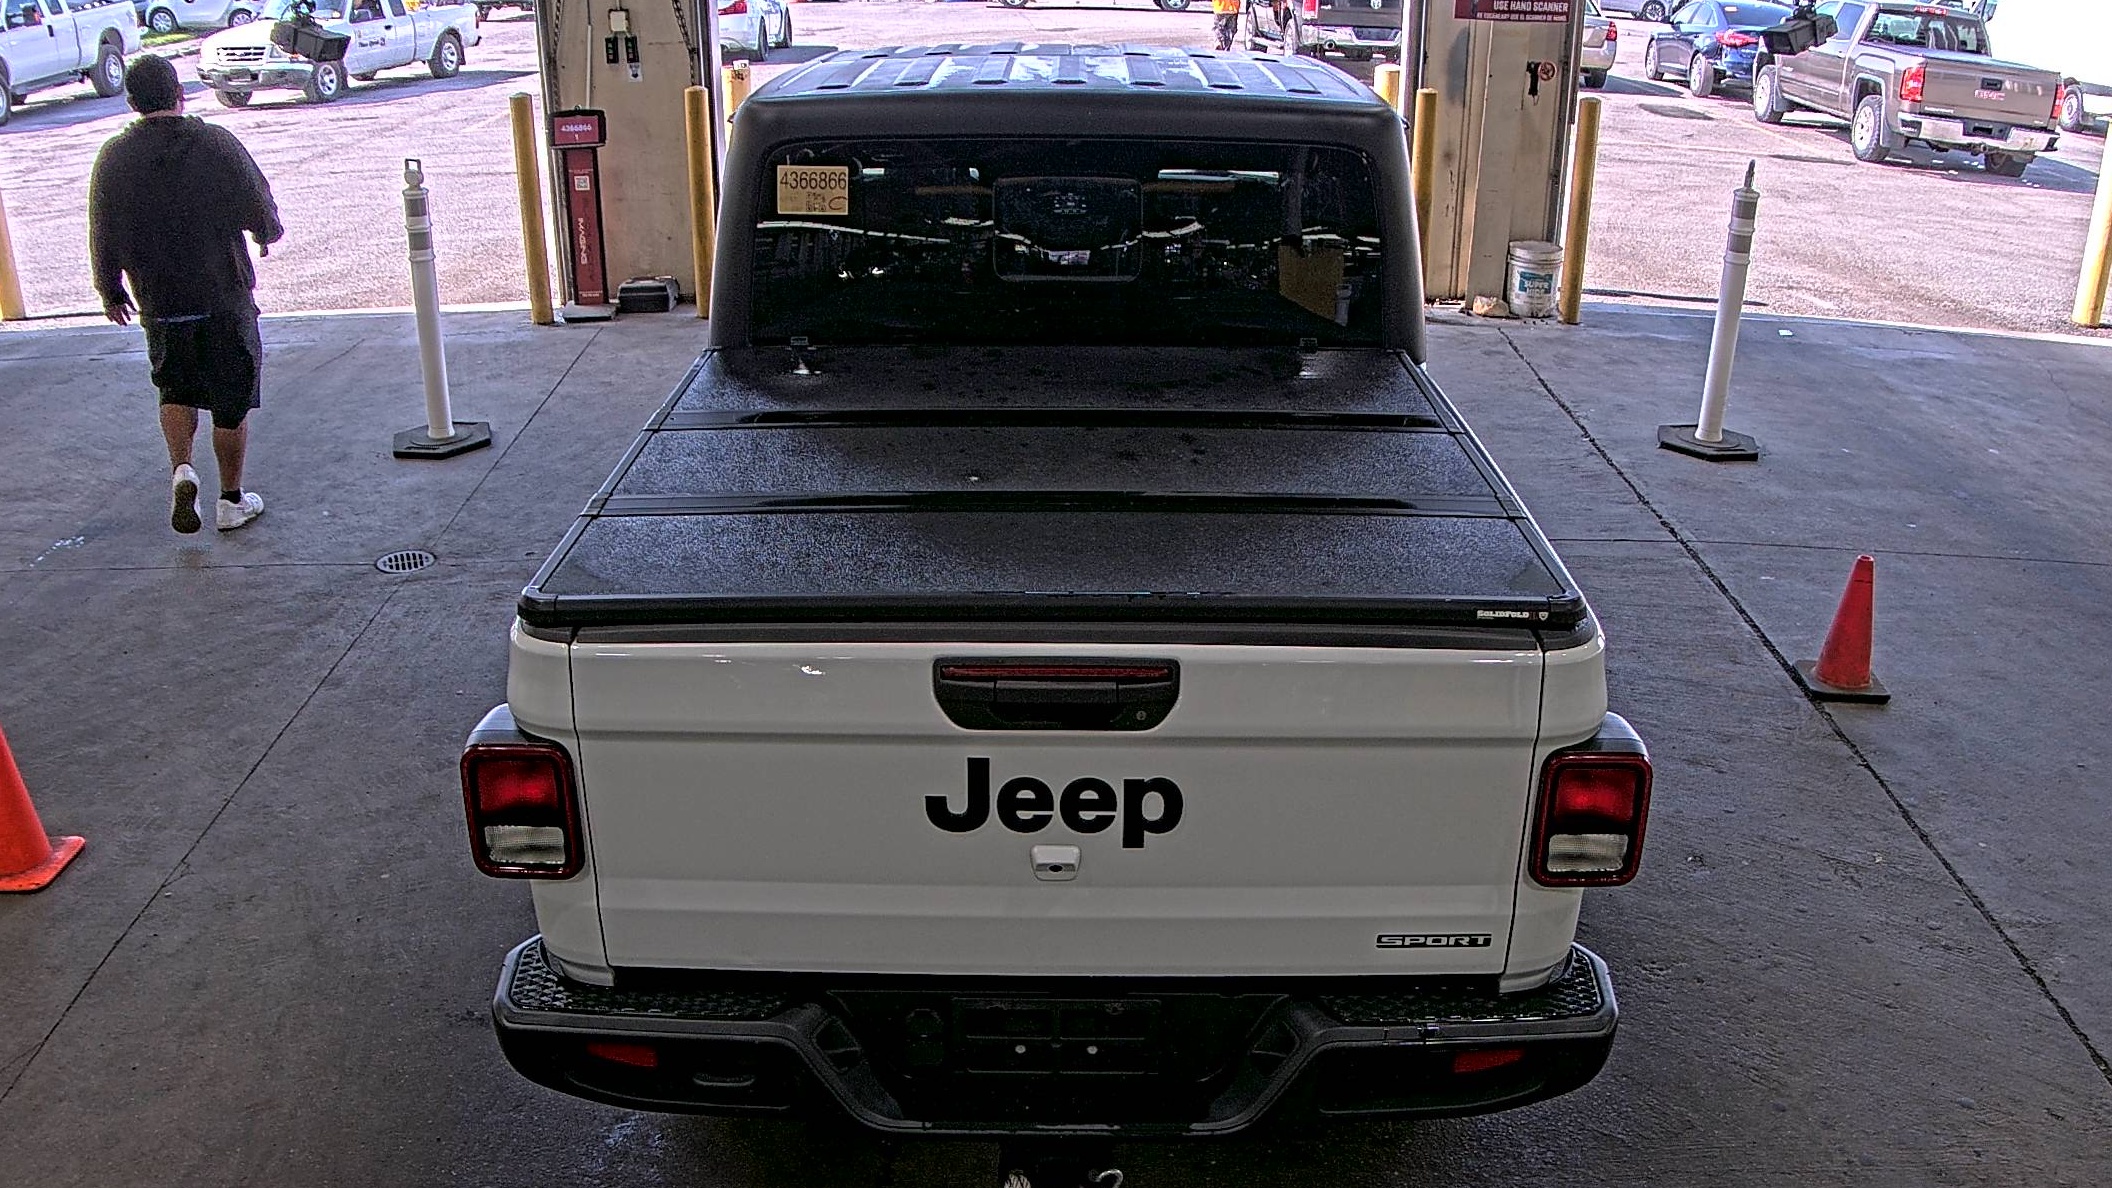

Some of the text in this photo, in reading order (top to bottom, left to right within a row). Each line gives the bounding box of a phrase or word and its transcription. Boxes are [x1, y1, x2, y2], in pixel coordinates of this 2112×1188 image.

[1493, 0, 1568, 12] USE HAND SCANNER
[780, 171, 847, 190] 4366866
[578, 217, 588, 264] IMAGING
[924, 757, 1184, 849] Jeep
[1378, 935, 1492, 946] SPORT
